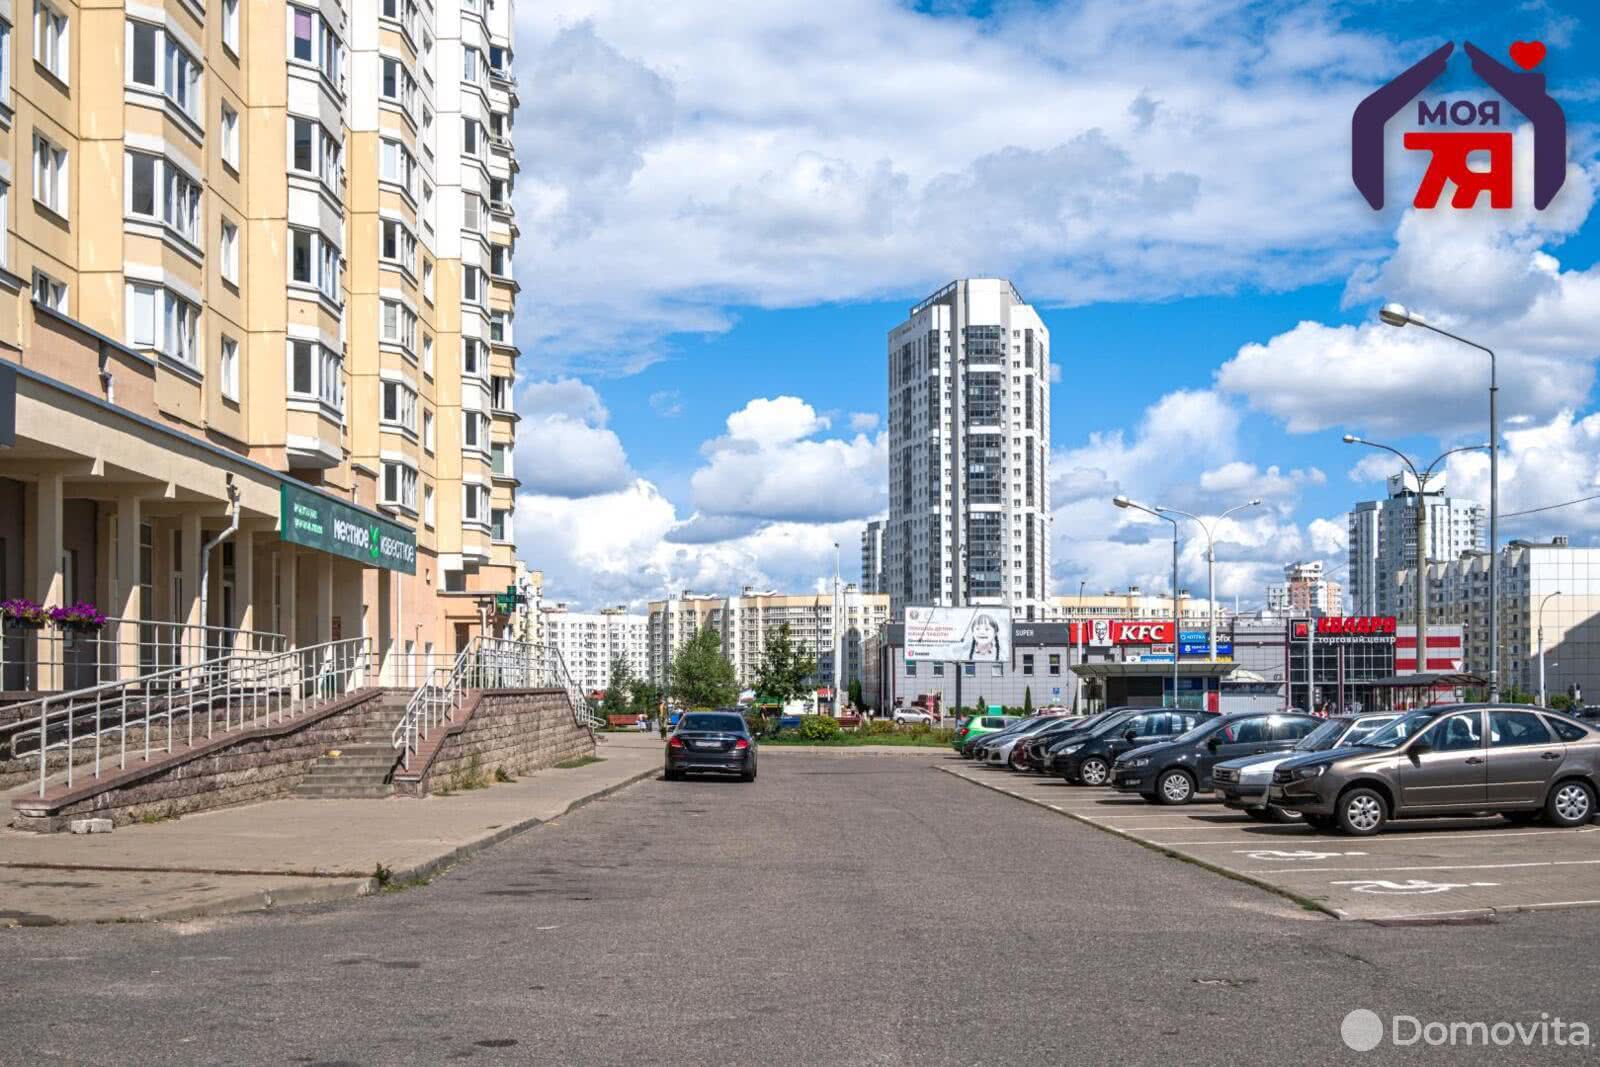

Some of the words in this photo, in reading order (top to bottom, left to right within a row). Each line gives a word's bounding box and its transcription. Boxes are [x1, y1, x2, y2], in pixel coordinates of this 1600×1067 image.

[1318, 616, 1396, 633] КВАДРО
[1016, 629, 1034, 637] SUPER
[1120, 625, 1165, 640] KFC
